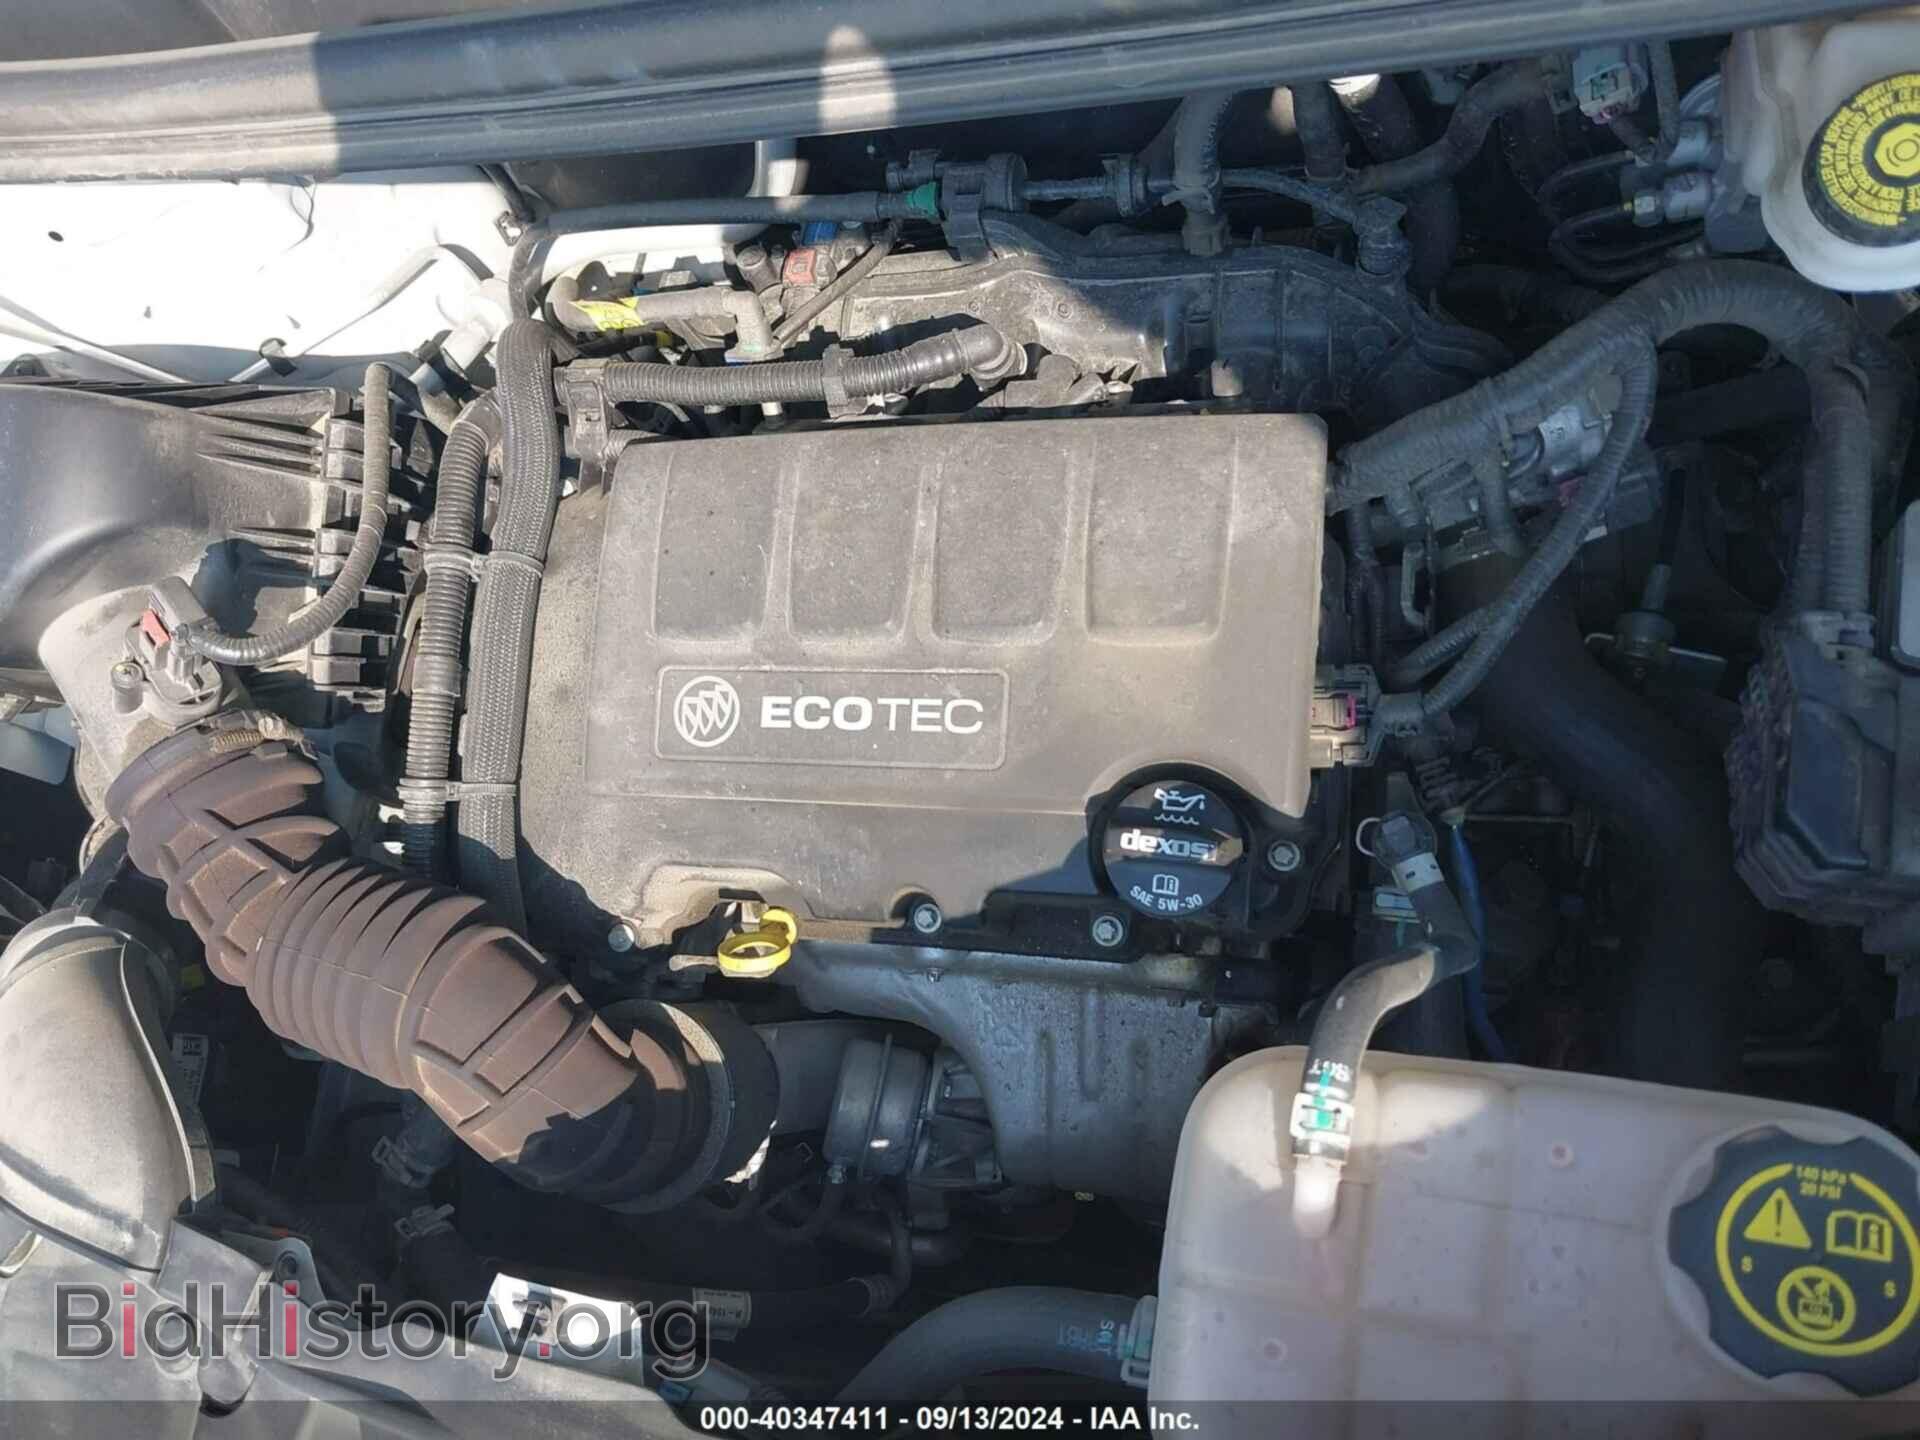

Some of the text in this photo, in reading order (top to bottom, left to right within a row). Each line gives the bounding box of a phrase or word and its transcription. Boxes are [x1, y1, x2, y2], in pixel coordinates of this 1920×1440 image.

[760, 695, 984, 734] ECOTEC
[1130, 885, 1203, 911] SAE 5W-30
[1800, 1182, 1841, 1200] 20 PSI
